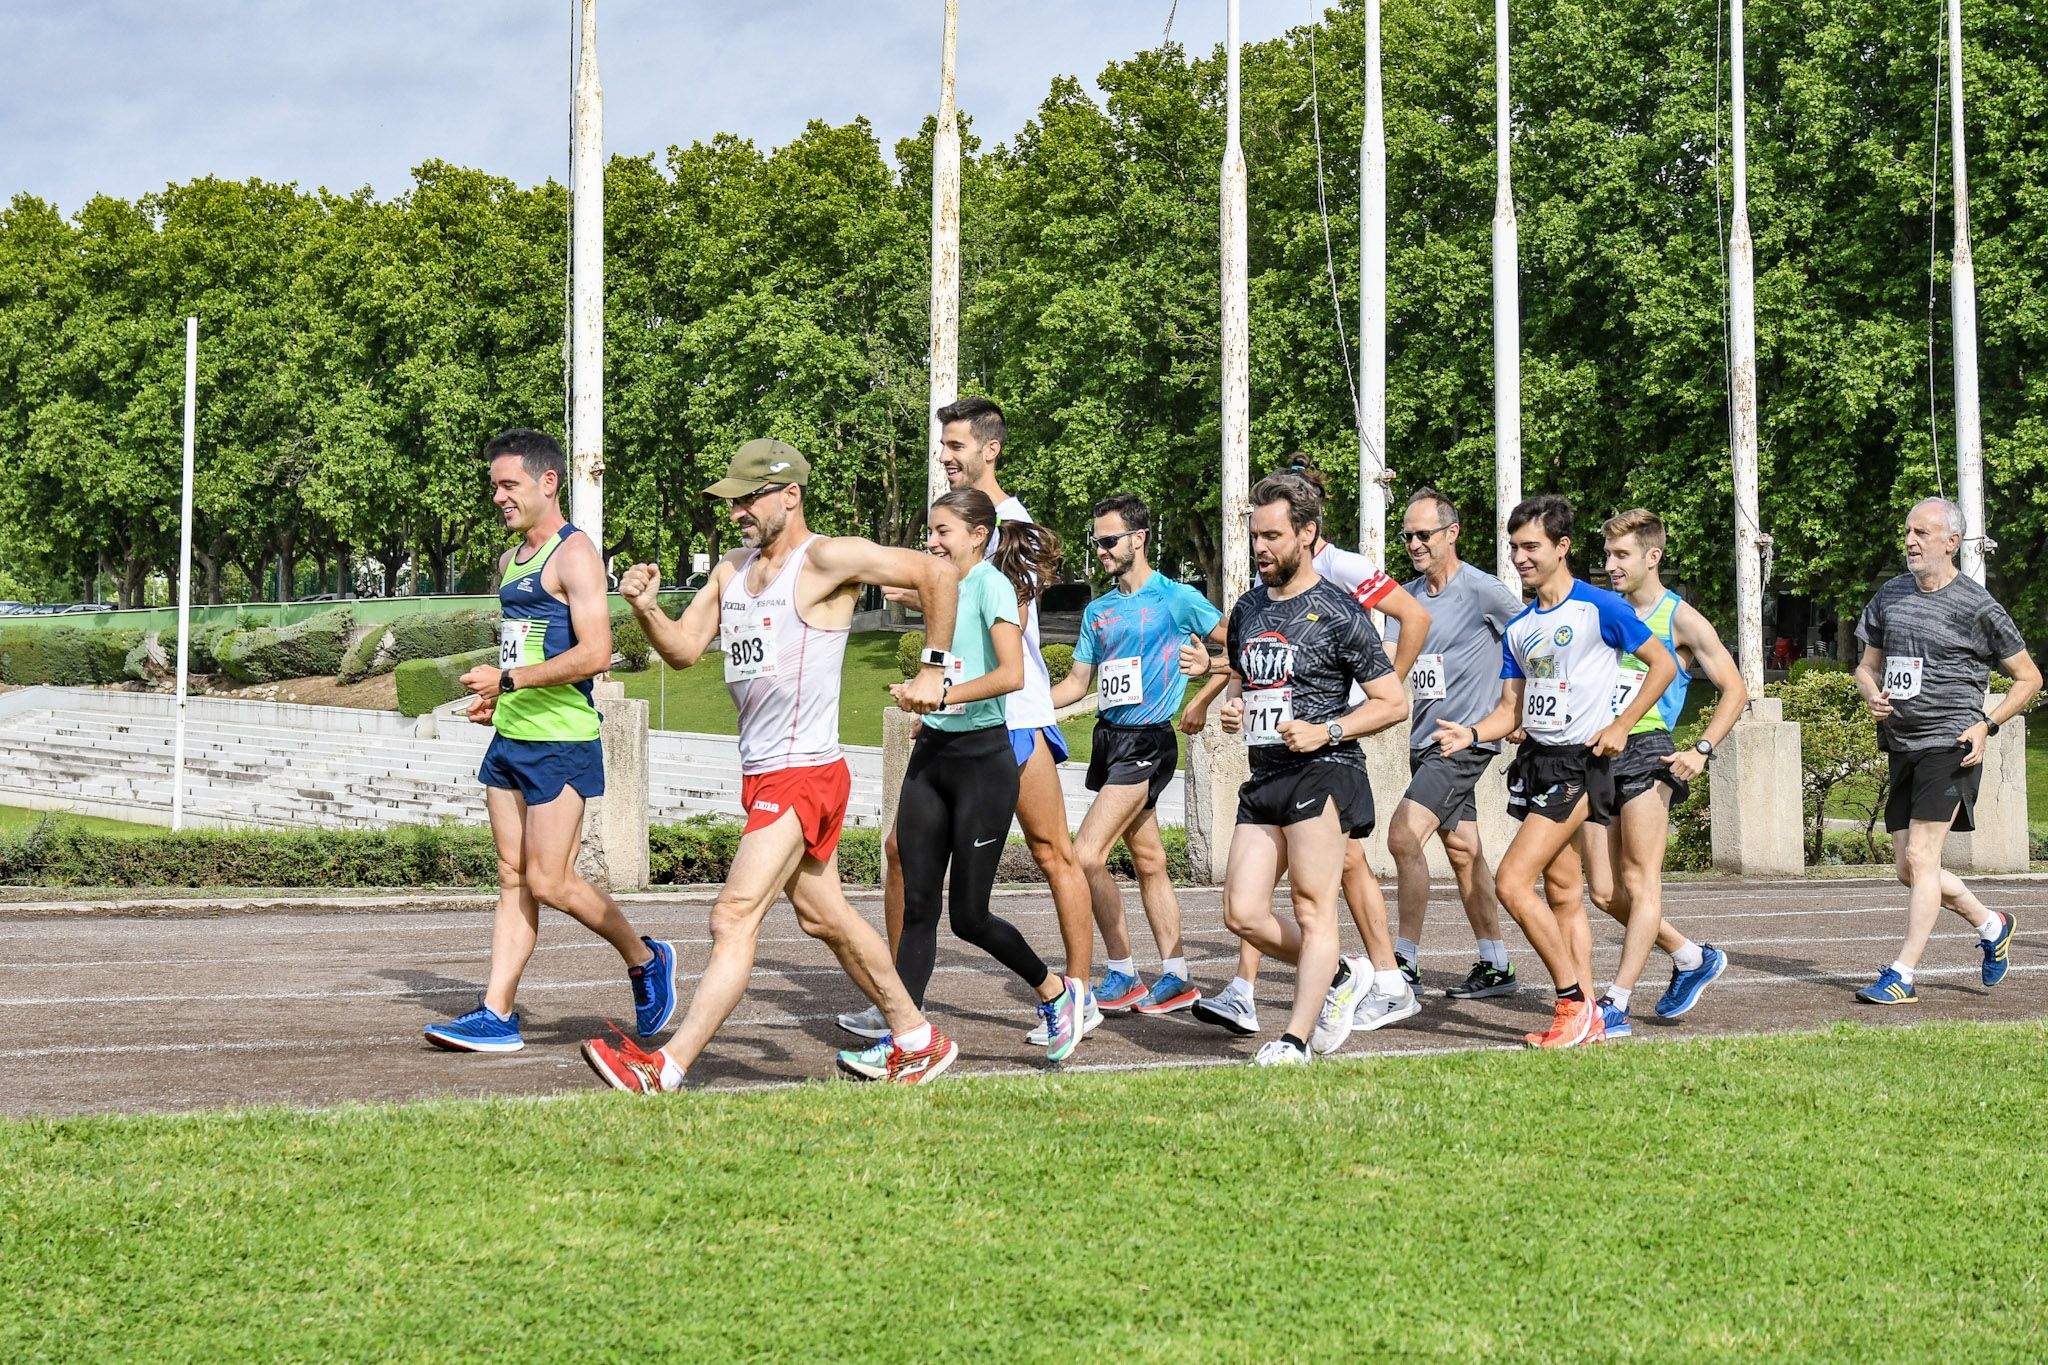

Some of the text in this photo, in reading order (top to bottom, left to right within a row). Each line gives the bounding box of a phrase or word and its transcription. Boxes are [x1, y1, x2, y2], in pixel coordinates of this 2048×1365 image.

[731, 637, 764, 666] 803
[1101, 674, 1131, 698] 905
[1413, 670, 1436, 689] 906
[1888, 672, 1912, 690] 849
[1528, 694, 1557, 717] 892
[1615, 684, 1632, 704] 7
[1249, 707, 1283, 732] 717
